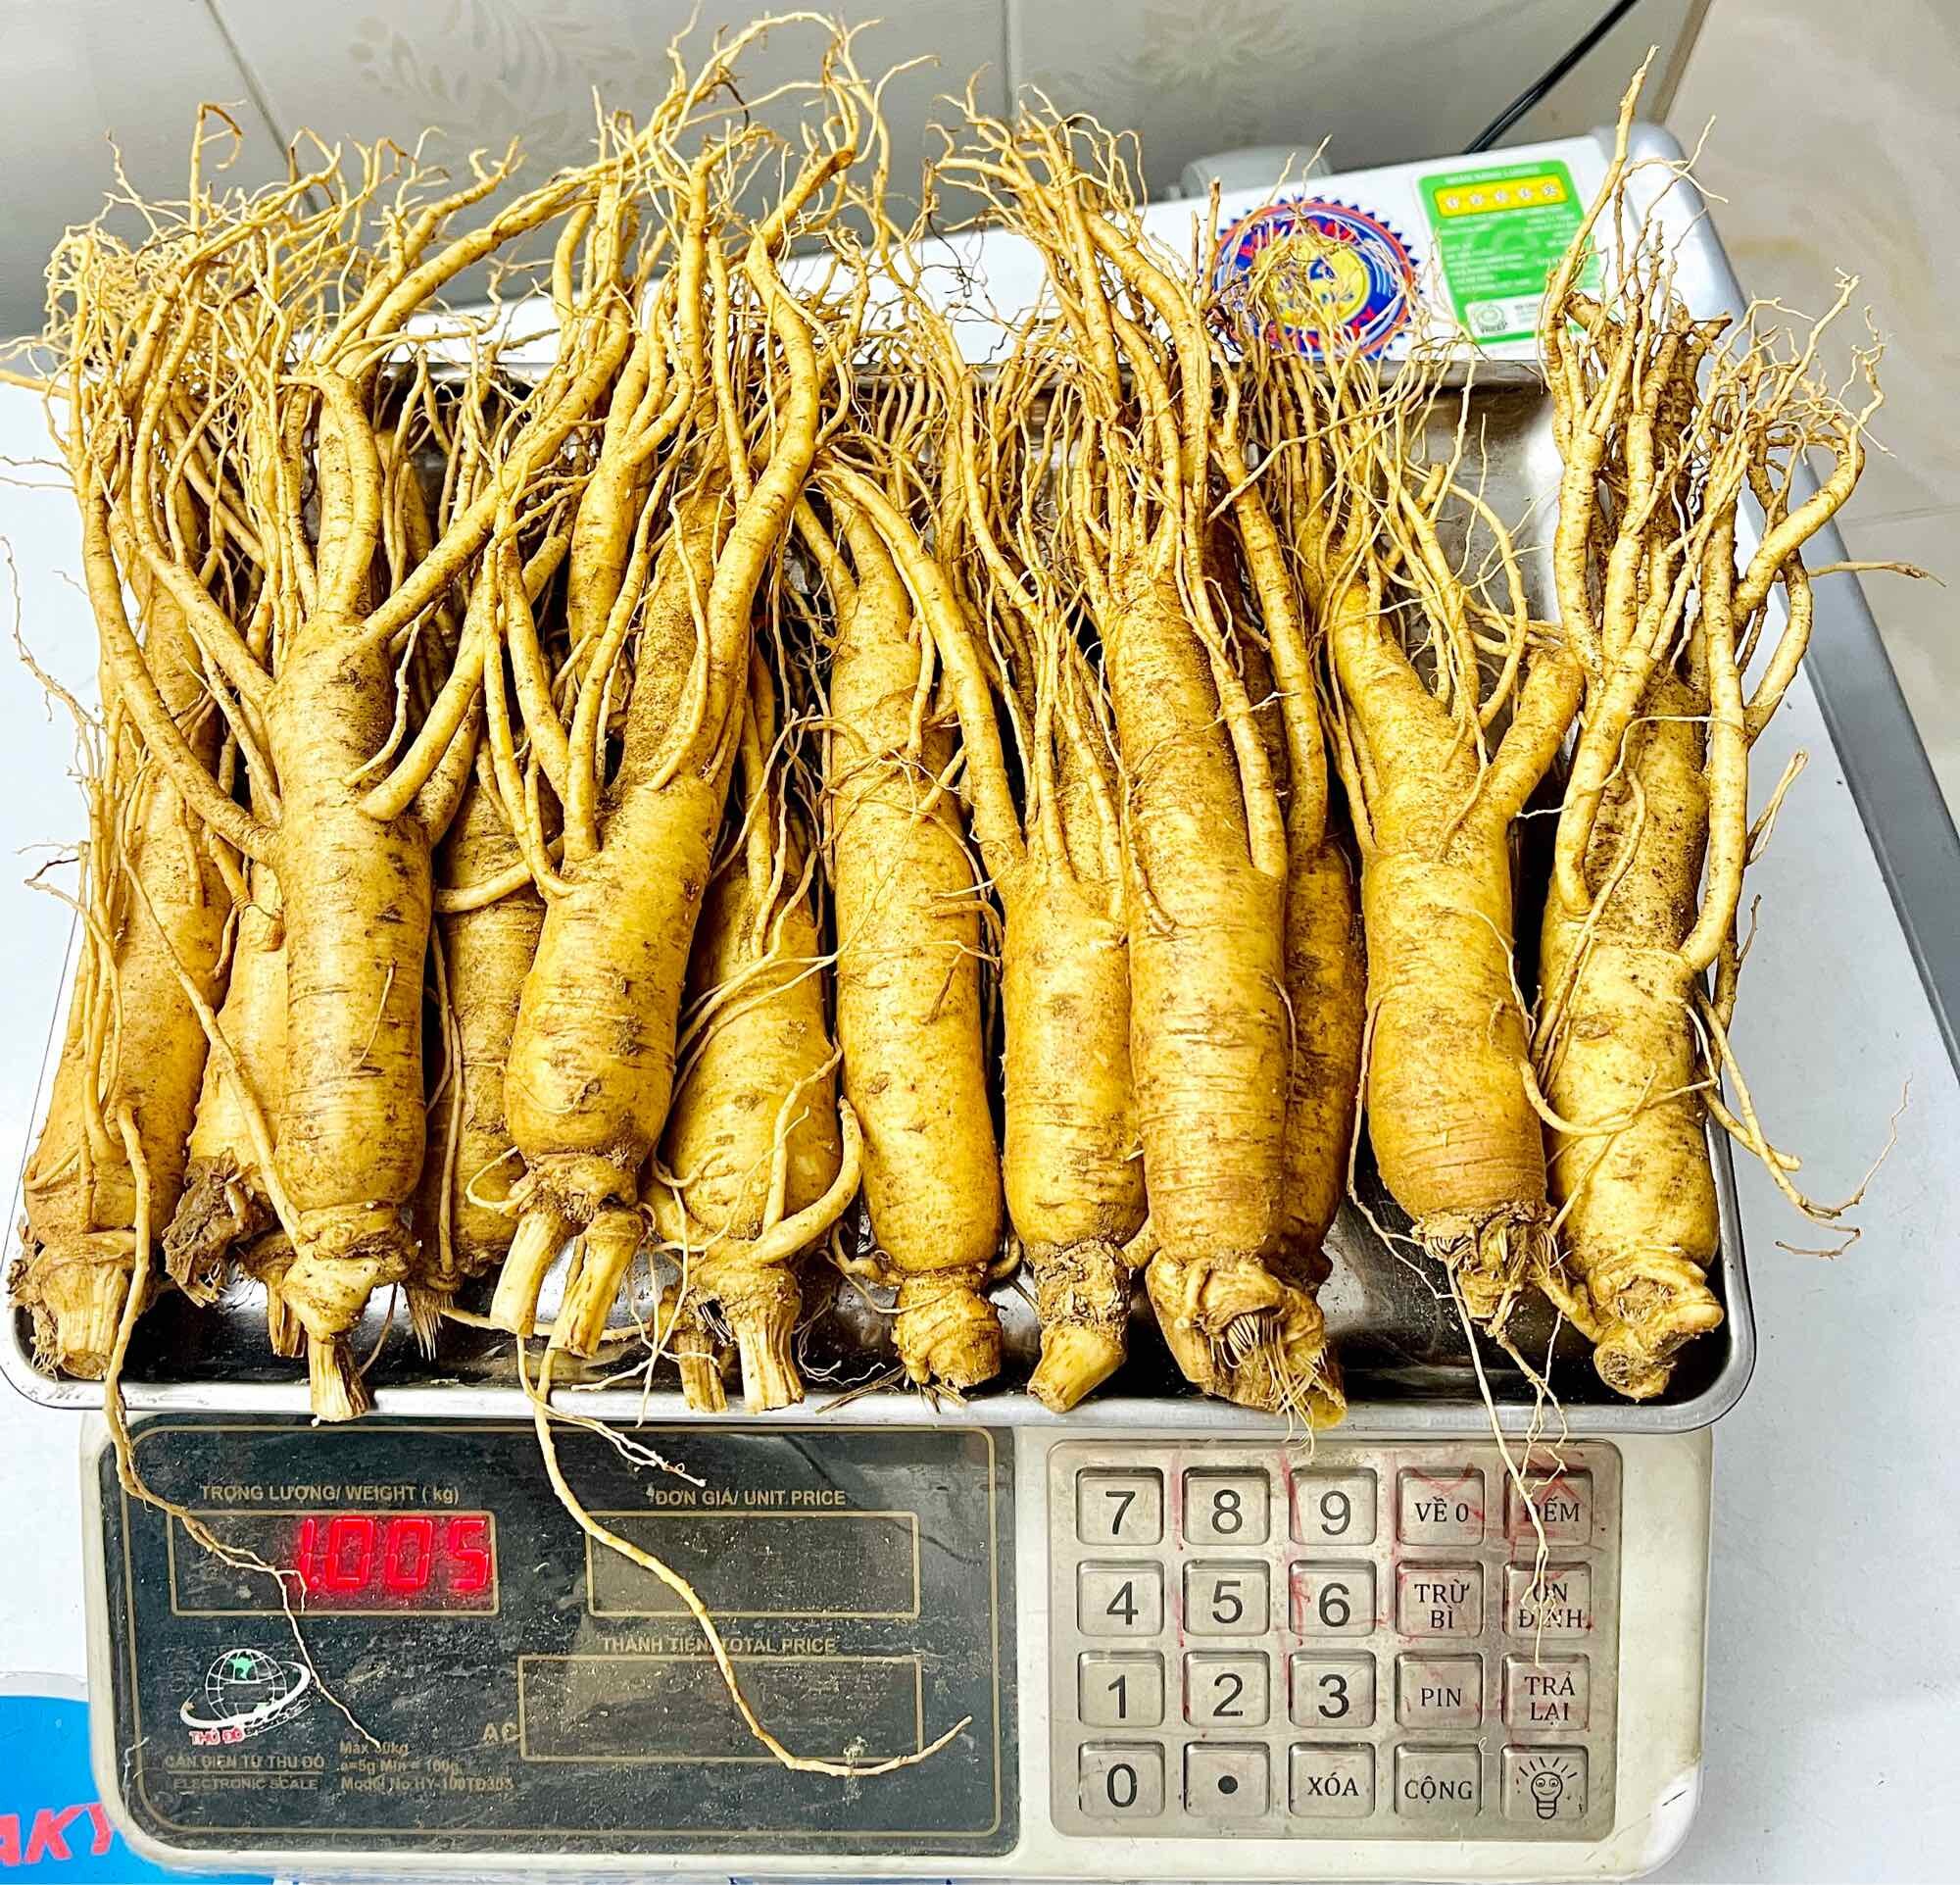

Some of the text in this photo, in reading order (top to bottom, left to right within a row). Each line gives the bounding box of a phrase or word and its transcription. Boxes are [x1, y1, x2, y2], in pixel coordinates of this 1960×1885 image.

[202, 1484, 264, 1504] TRỌNG
[345, 1484, 416, 1501] WEIGHT
[656, 1489, 697, 1506] ĐƠN
[744, 1489, 785, 1505] UNIT
[791, 1489, 847, 1505] PRICE
[1105, 1489, 1352, 1536] 7 8 9
[1414, 1496, 1447, 1523] VỀ
[298, 1516, 490, 1590] 1.005
[1105, 1579, 1351, 1628] 4 5 6
[1414, 1579, 1471, 1604] TRỪ
[1430, 1606, 1454, 1630] BÌ
[782, 1636, 837, 1654] PRICE
[1105, 1672, 1351, 1719] 1 2 3
[1524, 1670, 1576, 1697] TRẢ
[1421, 1687, 1462, 1708] PIN
[1530, 1701, 1570, 1723] LẠI
[338, 1740, 369, 1755] Max
[270, 1776, 318, 1791] SCALE
[1105, 1763, 1137, 1809] 0
[1306, 1772, 1359, 1797] XÓA
[1403, 1775, 1473, 1803] CỘNG
